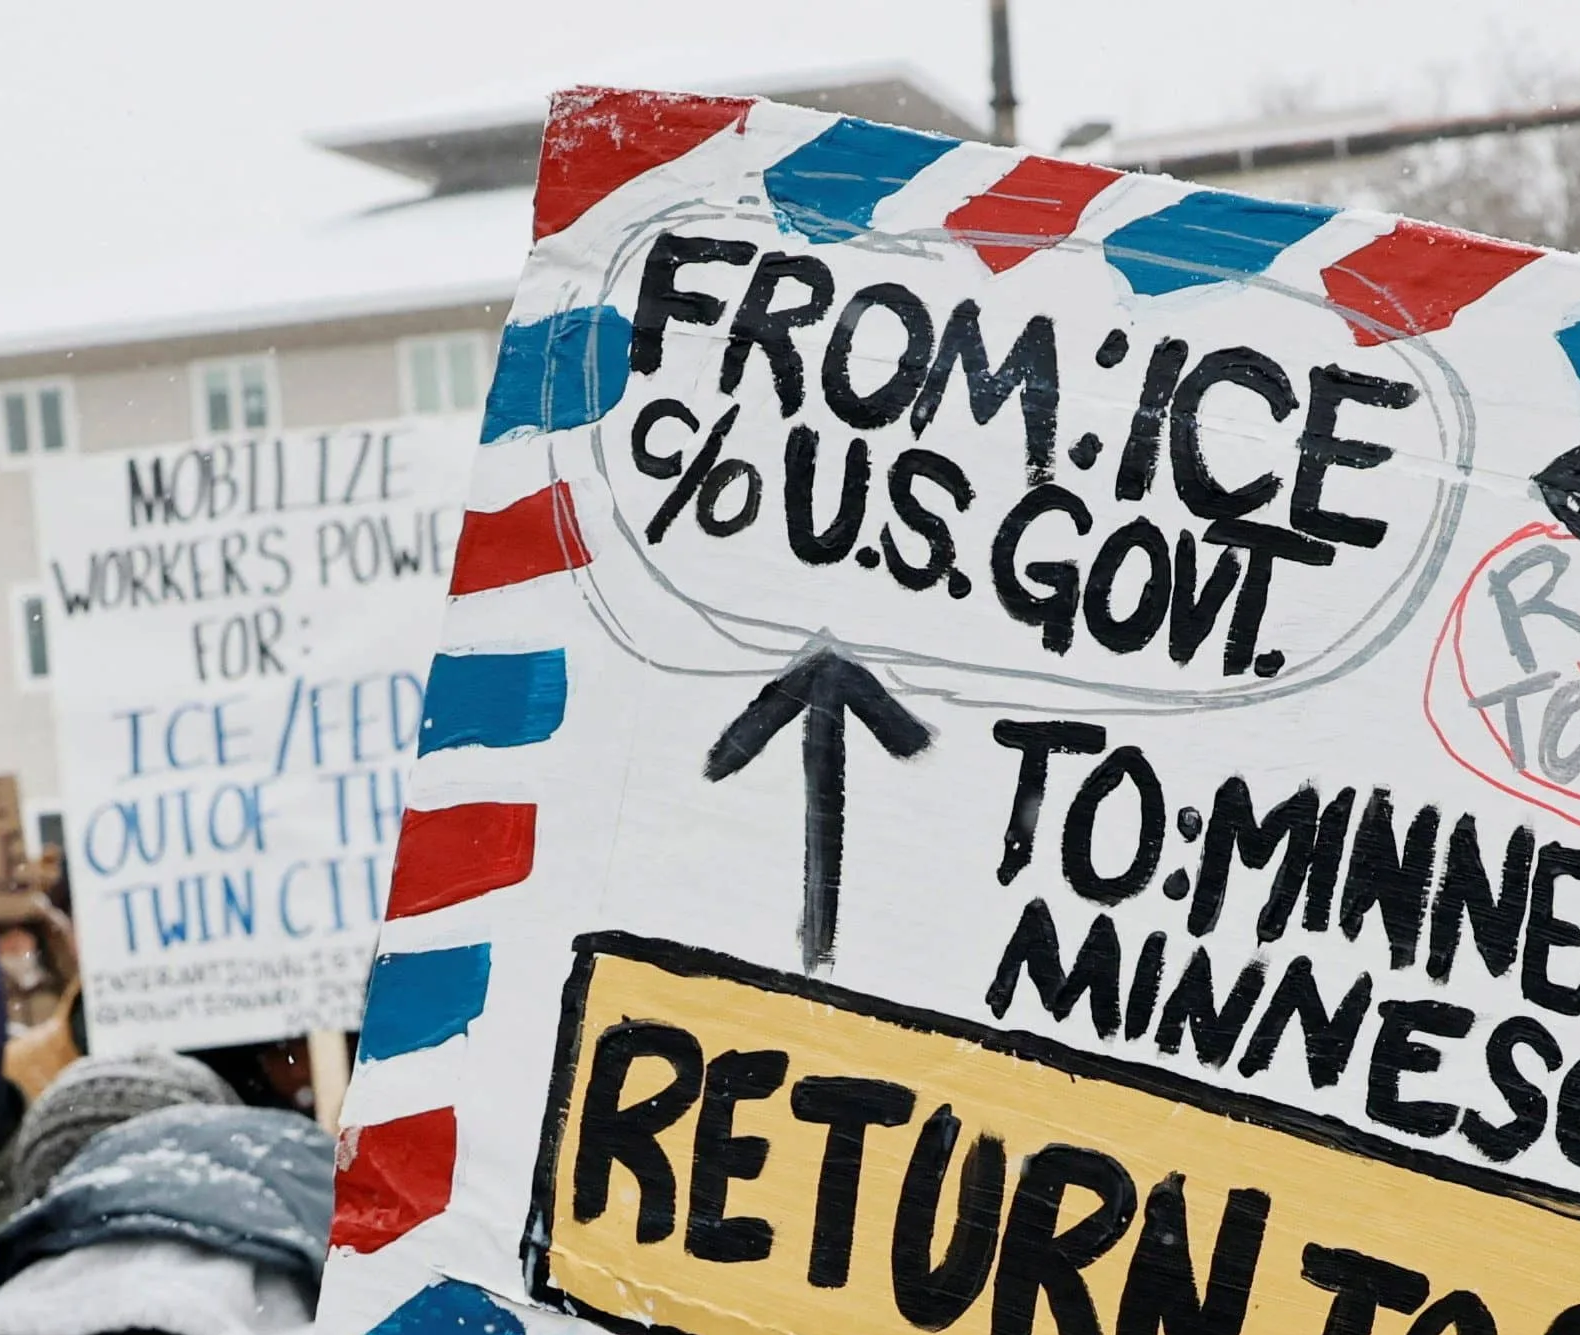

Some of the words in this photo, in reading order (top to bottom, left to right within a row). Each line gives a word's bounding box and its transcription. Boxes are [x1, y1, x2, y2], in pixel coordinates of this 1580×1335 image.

[629, 231, 1129, 486] FROM:
[1115, 336, 1422, 548] ICE
[128, 427, 415, 527] MOBILIZE
[782, 424, 975, 599] U.S.
[50, 523, 293, 618] WORKERS
[317, 502, 458, 588] POWE
[192, 604, 312, 682] FOR:
[317, 768, 405, 845] TH
[993, 719, 1202, 905] TO:
[105, 868, 256, 957] TWIN
[277, 853, 382, 940] CIT
